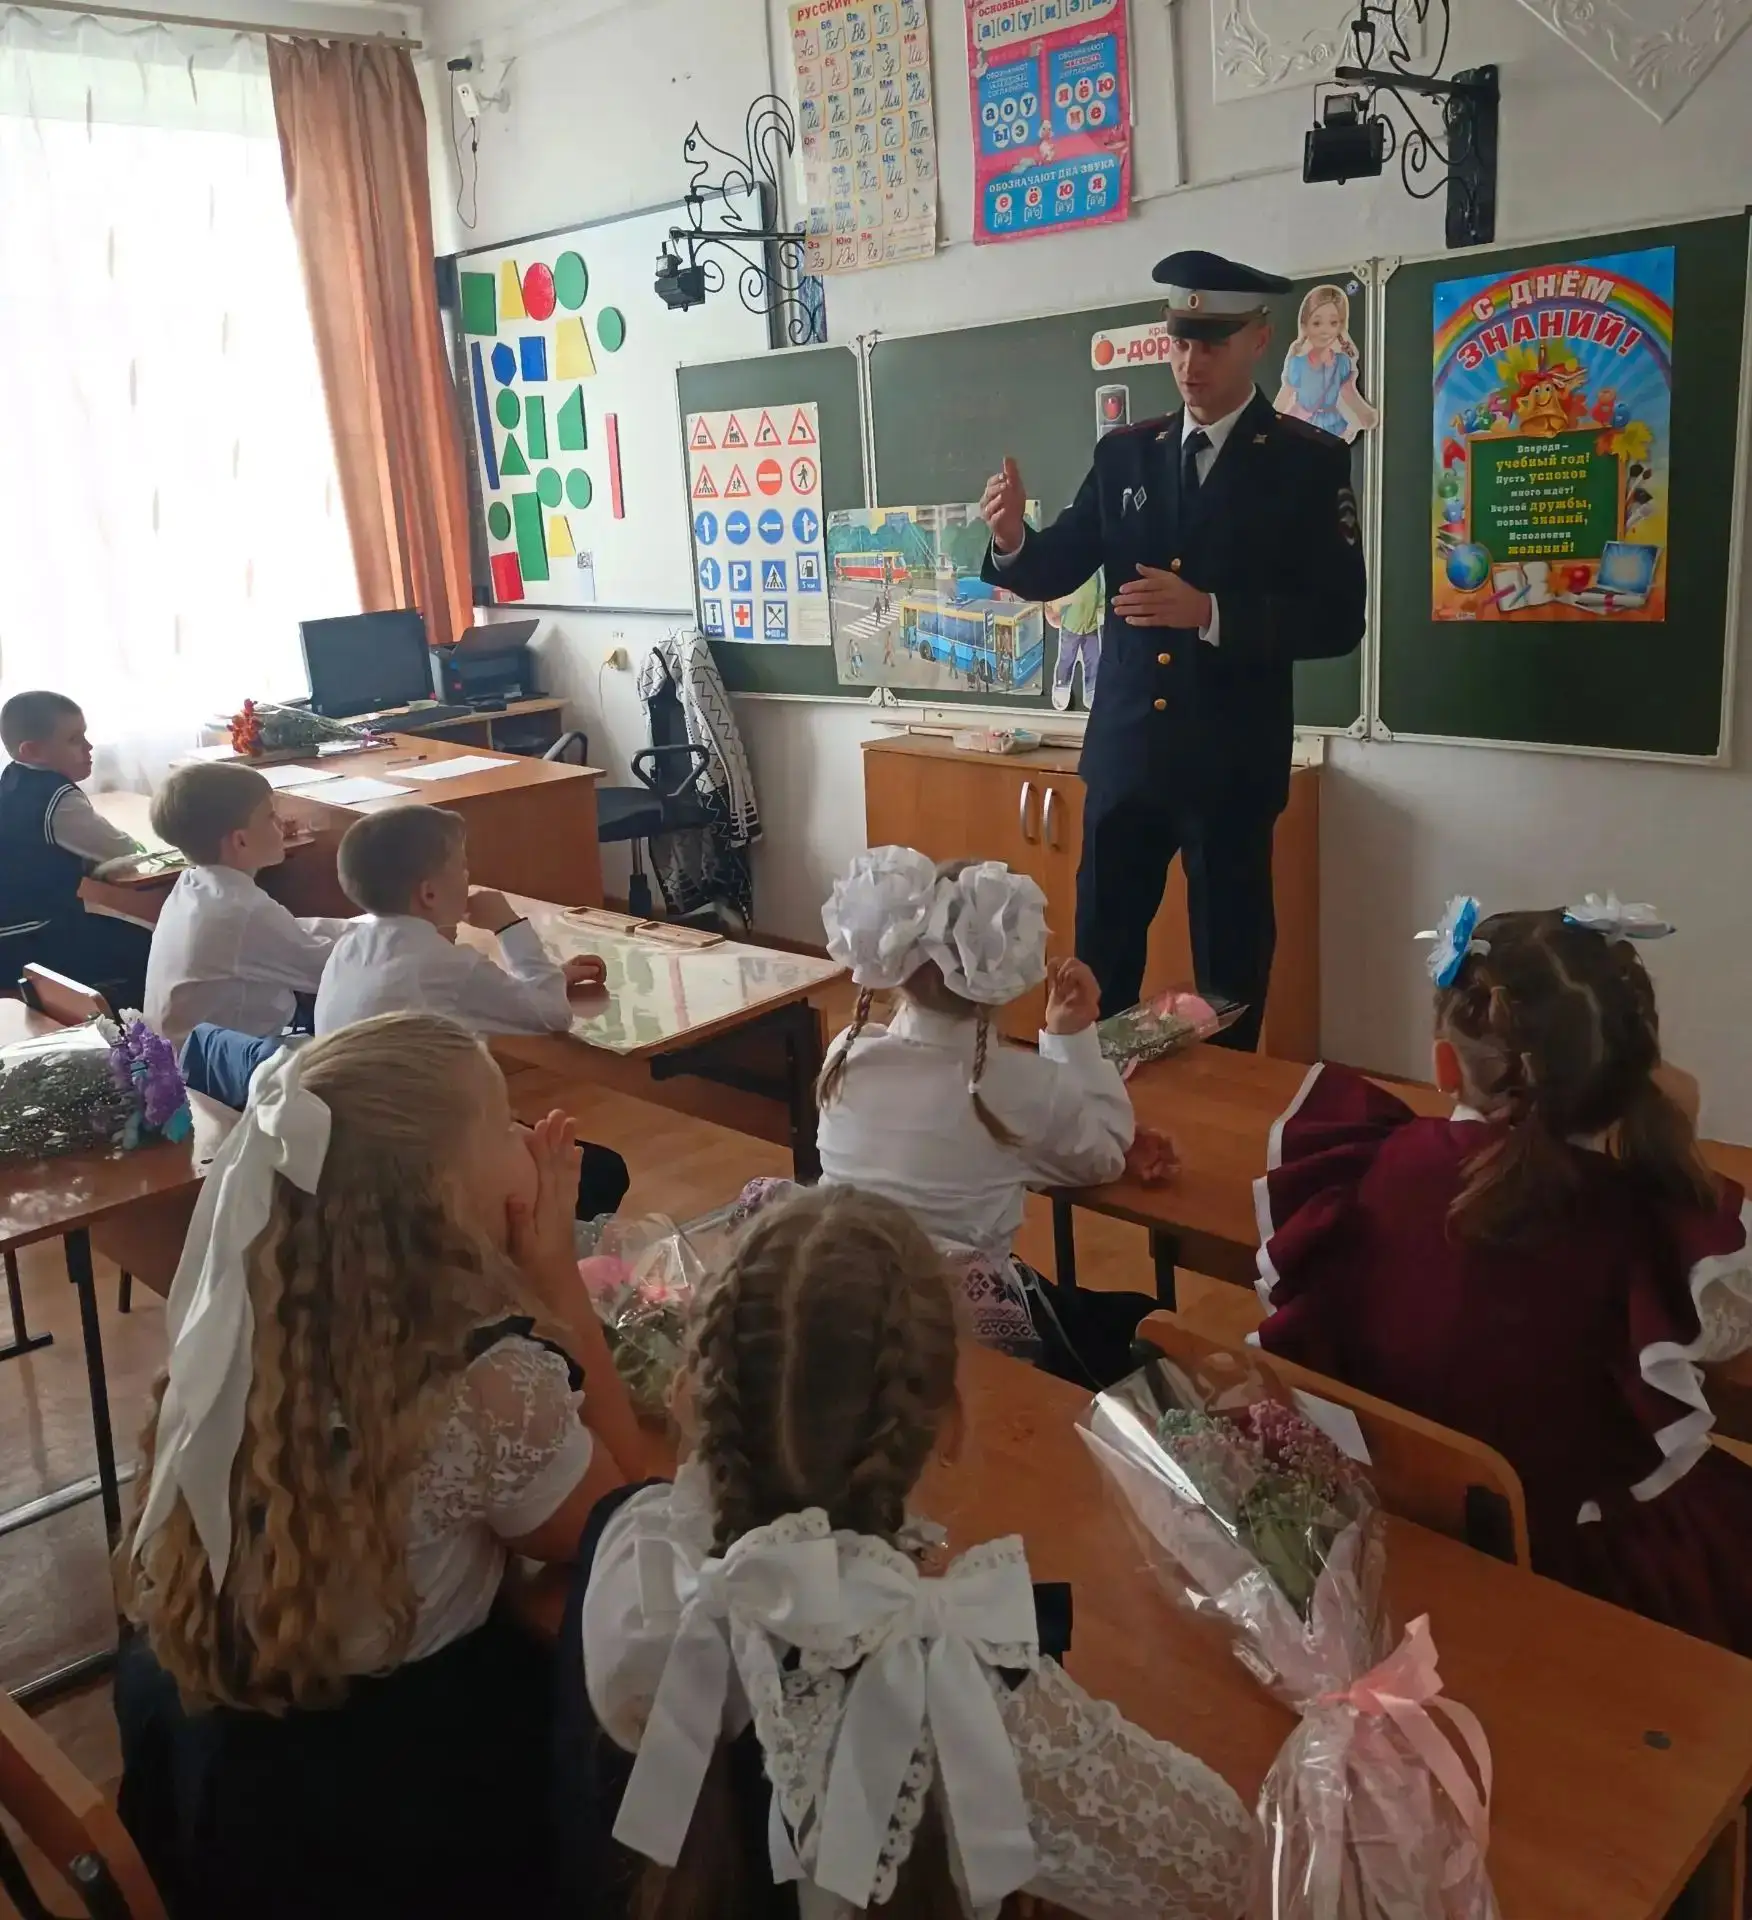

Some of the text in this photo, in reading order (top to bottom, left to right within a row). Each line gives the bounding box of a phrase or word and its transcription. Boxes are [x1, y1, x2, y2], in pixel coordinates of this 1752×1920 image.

[989, 172, 1057, 193] ОБОЗНАЧАЮТ
[1080, 159, 1115, 174] ЗВУКА
[1473, 270, 1615, 321] С ДНЁМ
[1456, 309, 1642, 370] ЗНАНИЙ!
[1517, 443, 1560, 454] Впереди
[1496, 452, 1590, 472] учебный год!
[1496, 470, 1586, 485] Пусть успехов
[1511, 489, 1541, 497] много
[1490, 497, 1592, 513] Верной дружбы,
[1496, 512, 1588, 527] новых знаний,
[1508, 542, 1574, 555] желаний!
